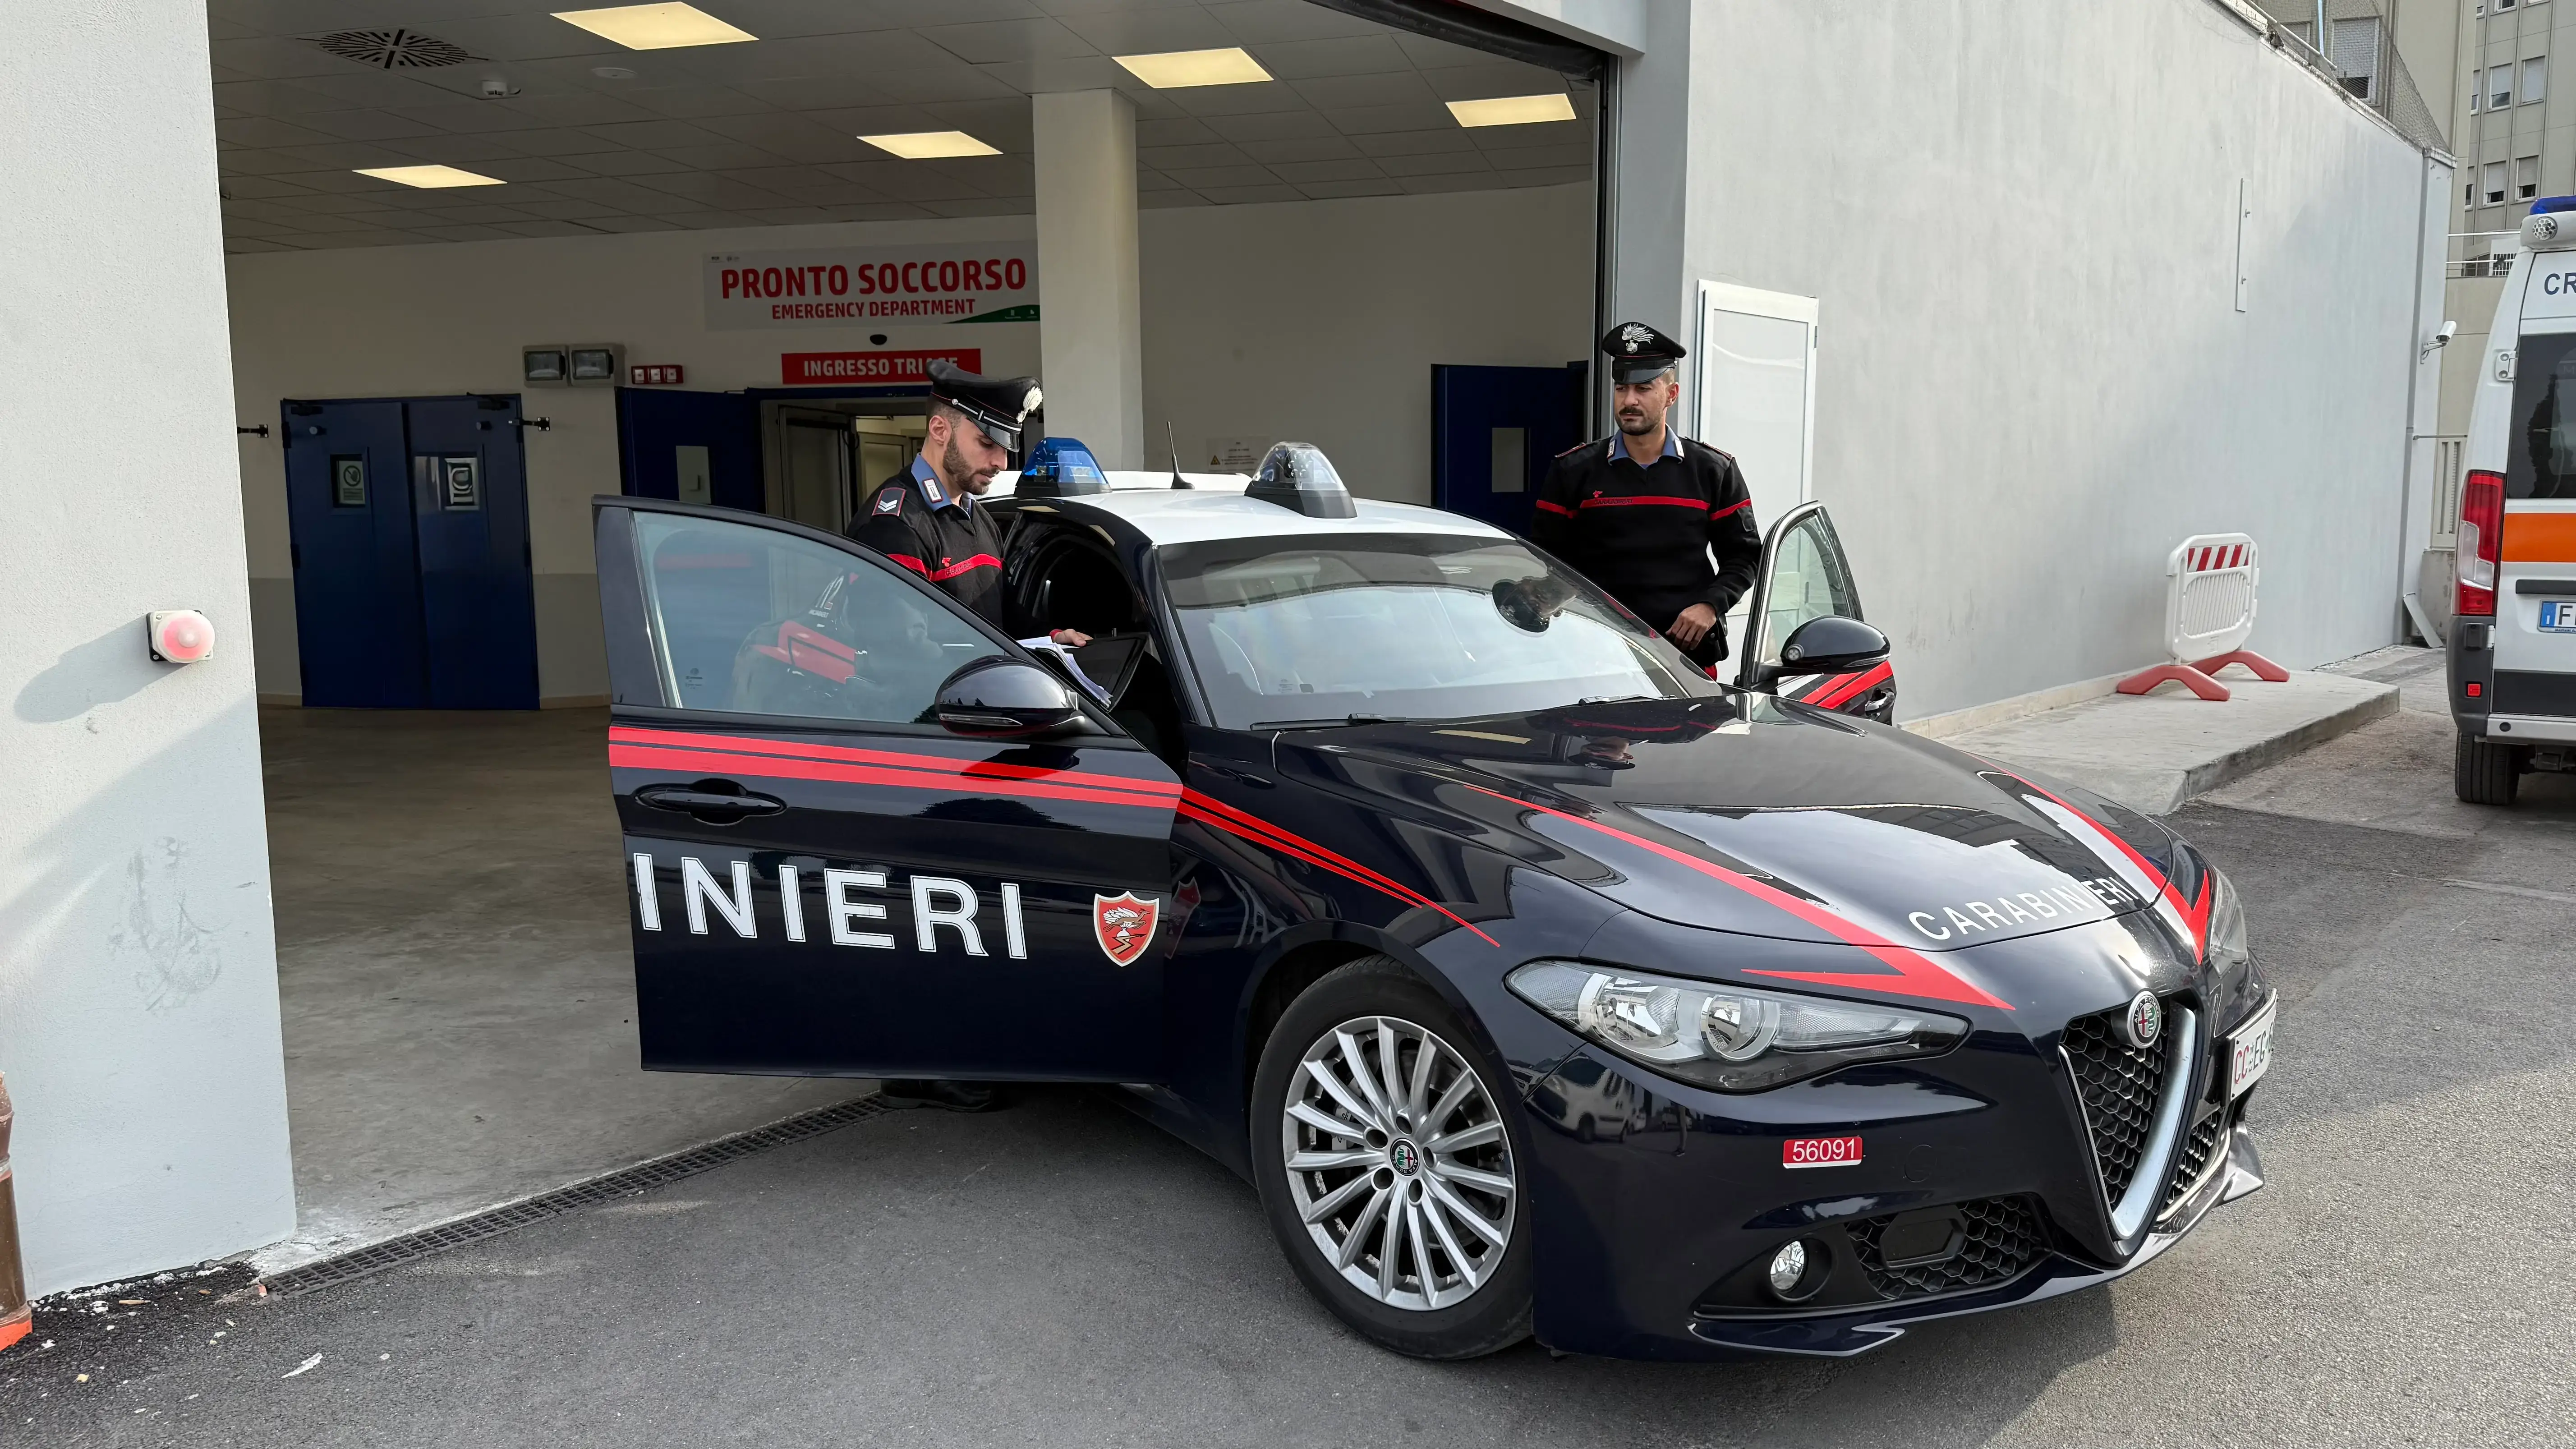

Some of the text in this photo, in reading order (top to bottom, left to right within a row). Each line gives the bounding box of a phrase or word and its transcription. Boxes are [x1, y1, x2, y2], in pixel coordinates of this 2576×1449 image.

[722, 258, 1026, 299] PRONTO SOCCORSO
[772, 299, 976, 320] EMERGENCY DEPARTMENT
[804, 357, 957, 377] INGRESSO TRIE
[2558, 605, 2576, 626] F
[1908, 876, 2139, 940] CARABINIERI
[2235, 1044, 2249, 1084] CC
[1792, 1138, 1855, 1162] 56091
